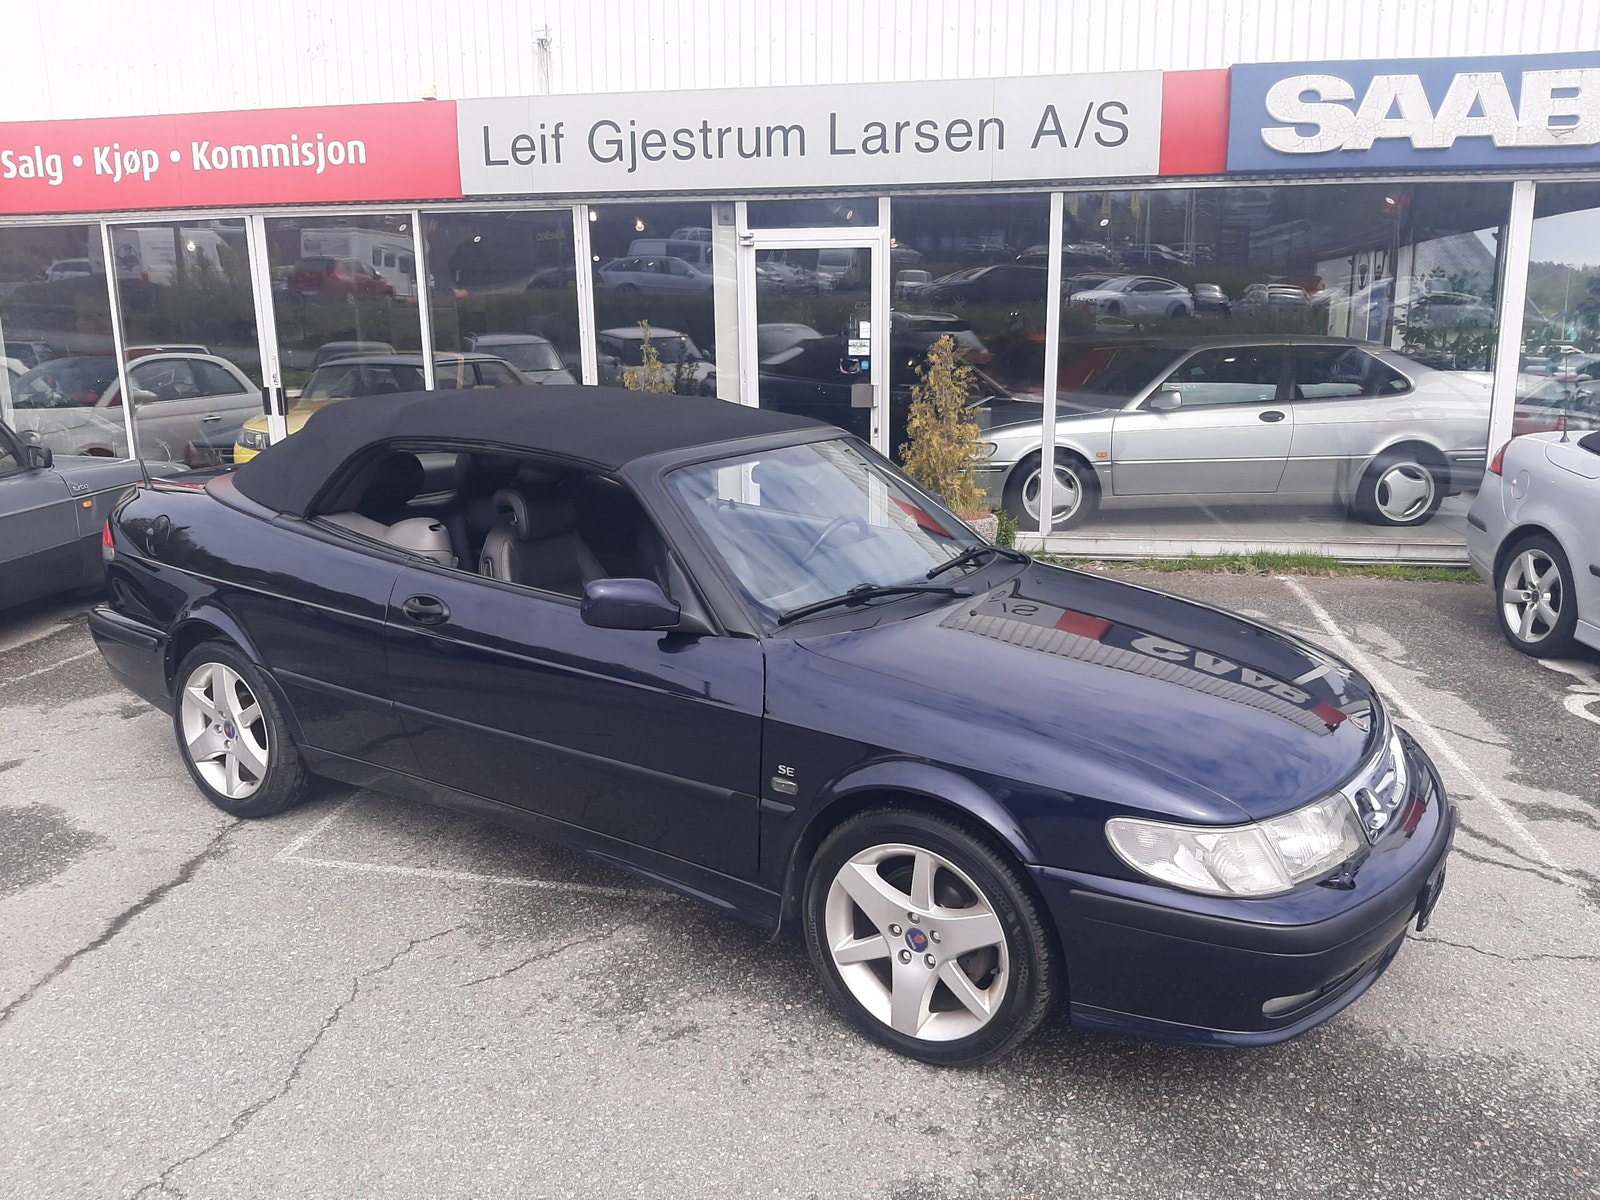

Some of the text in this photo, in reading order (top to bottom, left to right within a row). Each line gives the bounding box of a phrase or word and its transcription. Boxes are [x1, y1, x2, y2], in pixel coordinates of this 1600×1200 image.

[482, 101, 1129, 173] Leif Gjestrum Larsen A/S
[1261, 68, 1600, 153] SAAB
[1, 133, 367, 186] Salg Kjøp Kommisjon
[777, 764, 795, 777] SE
